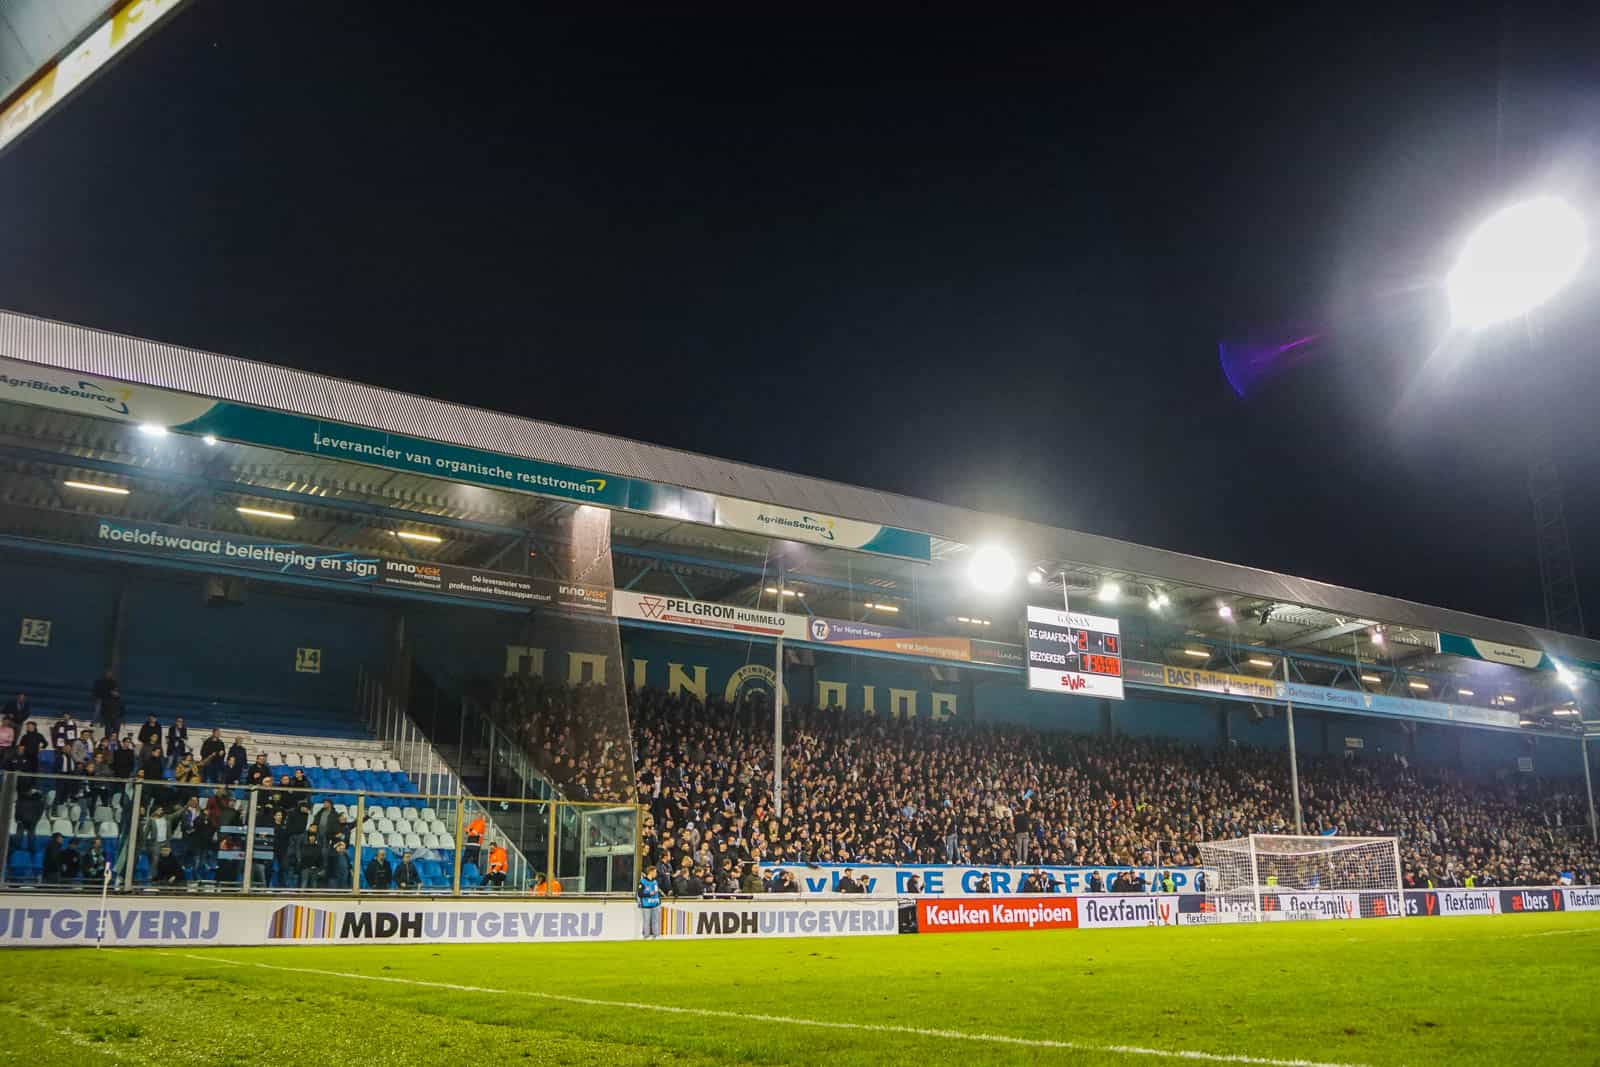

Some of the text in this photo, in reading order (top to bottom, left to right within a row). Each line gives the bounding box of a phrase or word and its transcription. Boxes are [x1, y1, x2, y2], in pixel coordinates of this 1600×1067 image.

[313, 432, 596, 494] Leverancier van organische reststromen
[756, 513, 827, 533] AgriBioSource
[98, 523, 377, 577] Roelofswaard belettering en sign
[666, 599, 735, 619] PELGROM
[737, 612, 785, 627] HUMMELO
[1028, 628, 1038, 639] DE
[1030, 651, 1066, 665] BEZOEKERS
[1168, 669, 1191, 686] BAS
[1086, 897, 1171, 926] flexfamily
[1445, 893, 1495, 915] flexfamily
[926, 904, 1072, 927] Keuken Kampioen
